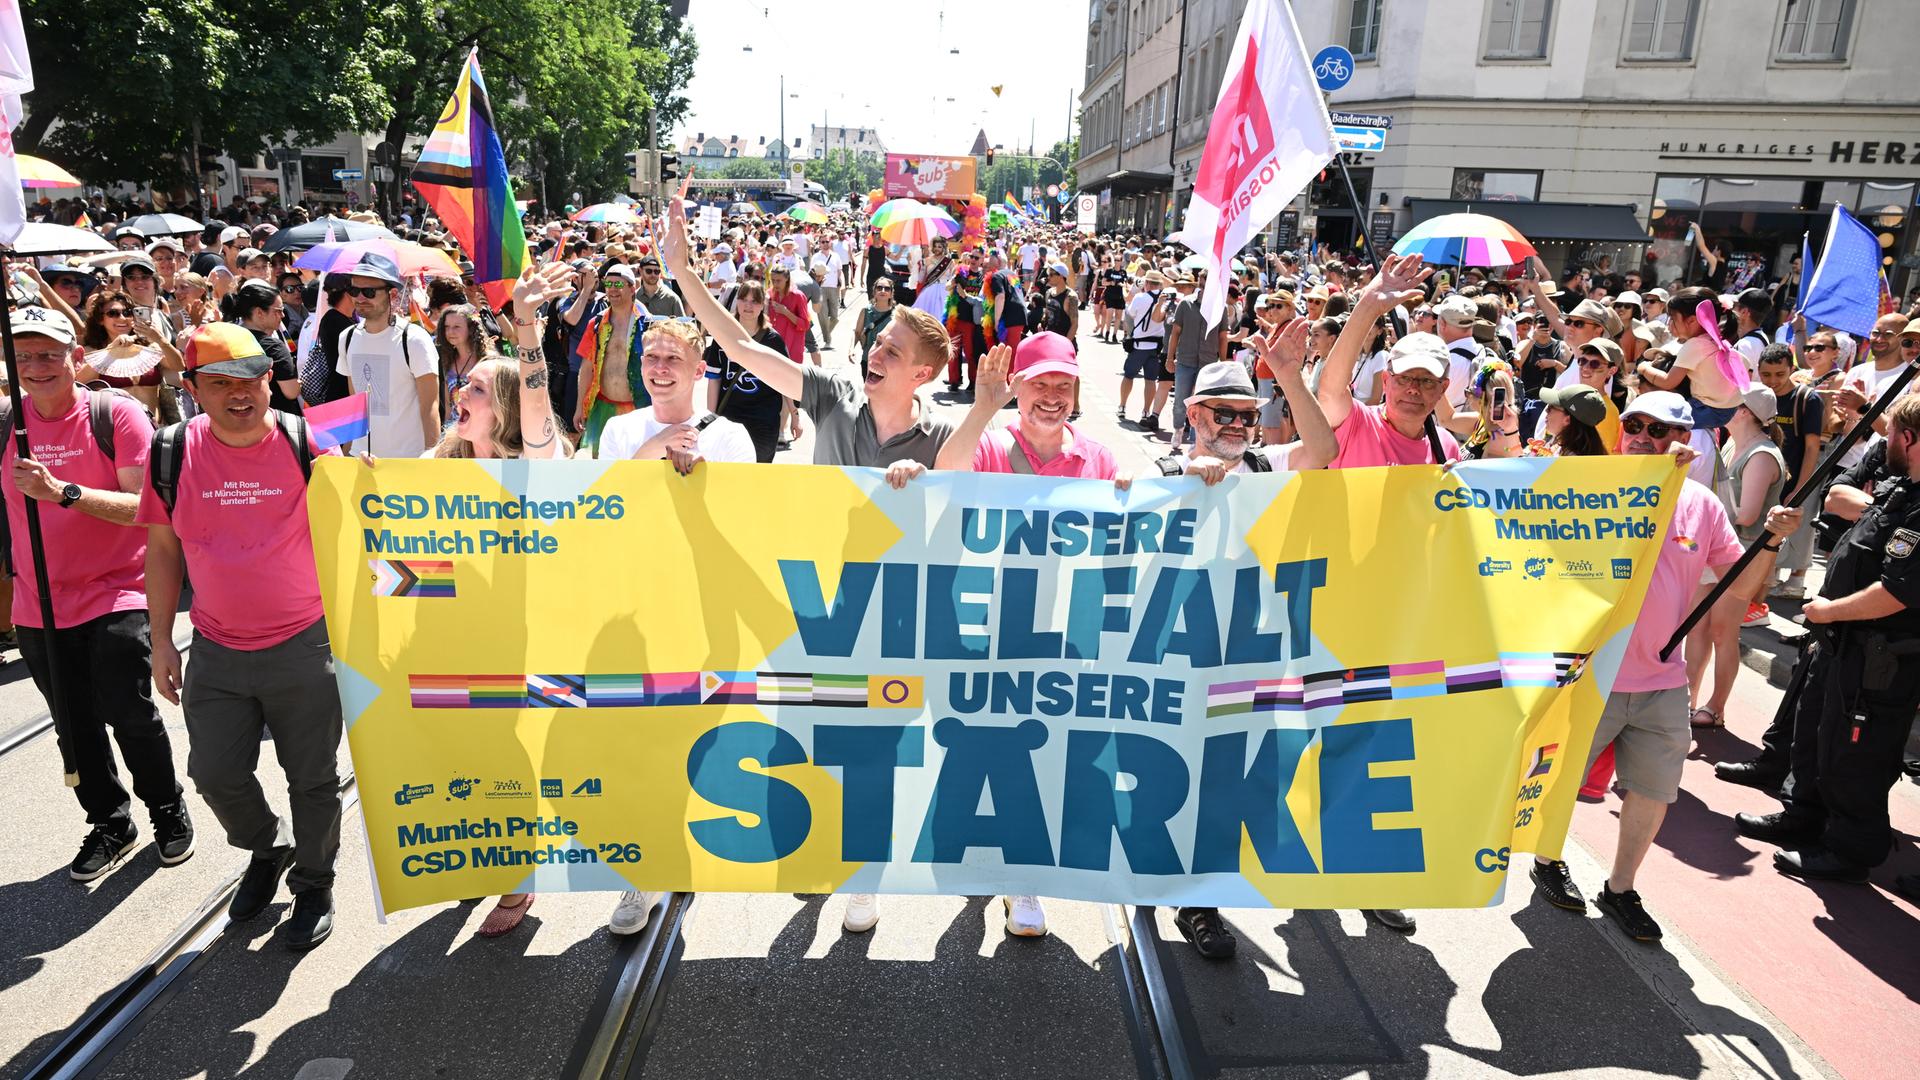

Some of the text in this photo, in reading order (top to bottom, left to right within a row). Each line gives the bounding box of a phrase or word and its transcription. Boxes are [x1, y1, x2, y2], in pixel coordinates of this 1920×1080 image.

[1332, 113, 1388, 127] Baaderstraße
[1660, 142, 1815, 155] HUNGRIGES
[917, 167, 943, 185] sub
[25, 309, 46, 321] NY
[59, 448, 83, 458] einfach
[202, 488, 282, 498] ist München einfach
[224, 481, 259, 489] Mit Rosa
[220, 497, 248, 506] bunter!
[360, 494, 429, 520] CSD
[1434, 487, 1491, 511] CSD
[961, 507, 1197, 556] UNSERE
[1495, 516, 1656, 540] Munich Pride
[364, 528, 558, 555] Munich Pride
[1527, 562, 1543, 573] sub
[777, 557, 1328, 668] VIELFALT
[948, 672, 1185, 725] UNSERE
[405, 785, 433, 796] diversity
[451, 782, 469, 794] sub
[687, 717, 1425, 875] STÄRKE
[1517, 780, 1543, 802] Pride
[397, 815, 579, 848] Munich Pride
[401, 849, 467, 877] CSD
[1475, 846, 1511, 873] CS
